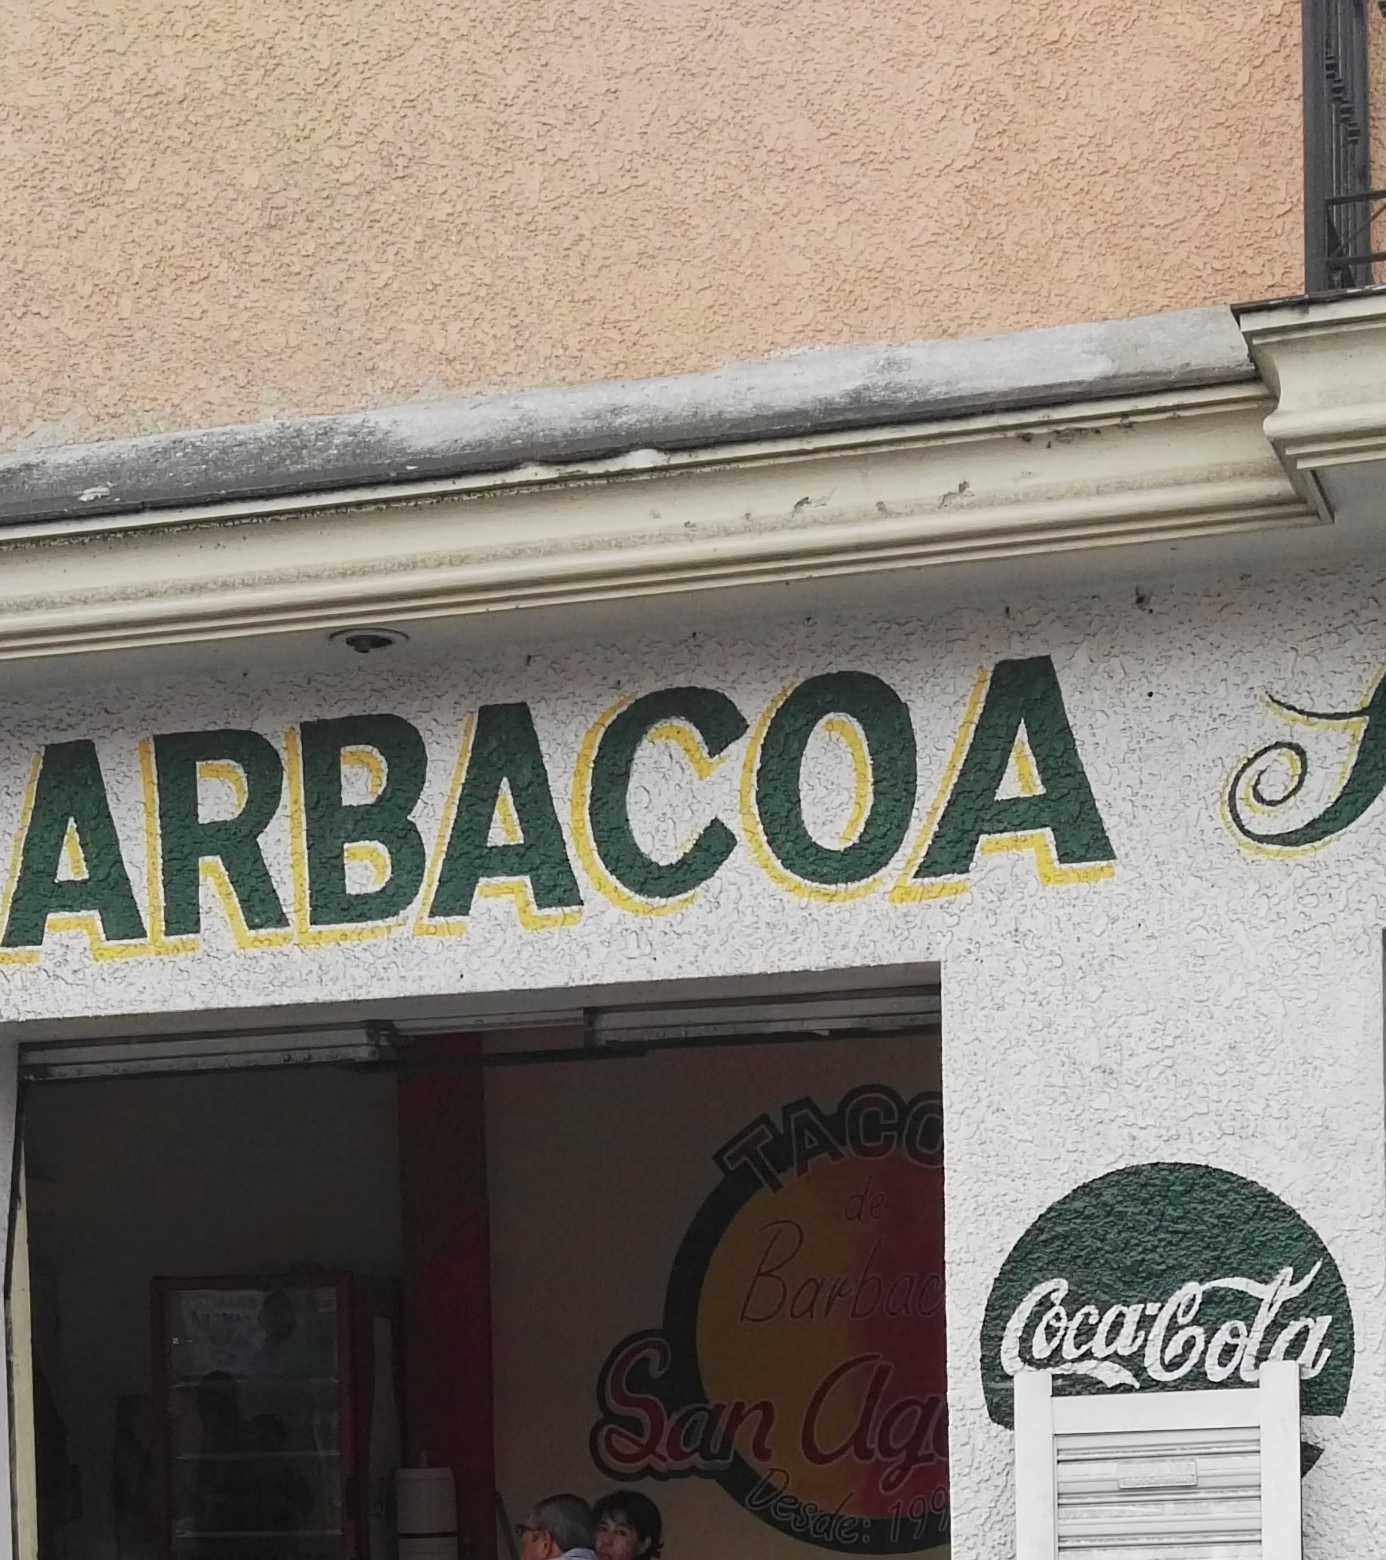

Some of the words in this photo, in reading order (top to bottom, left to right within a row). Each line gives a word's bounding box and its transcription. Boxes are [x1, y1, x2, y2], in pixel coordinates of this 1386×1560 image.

[844, 1177, 886, 1221] de
[1001, 1260, 1334, 1388] Coca-Cola
[601, 1337, 774, 1474] San
[800, 1352, 950, 1494] Ag
[745, 1468, 872, 1543] Desde:
